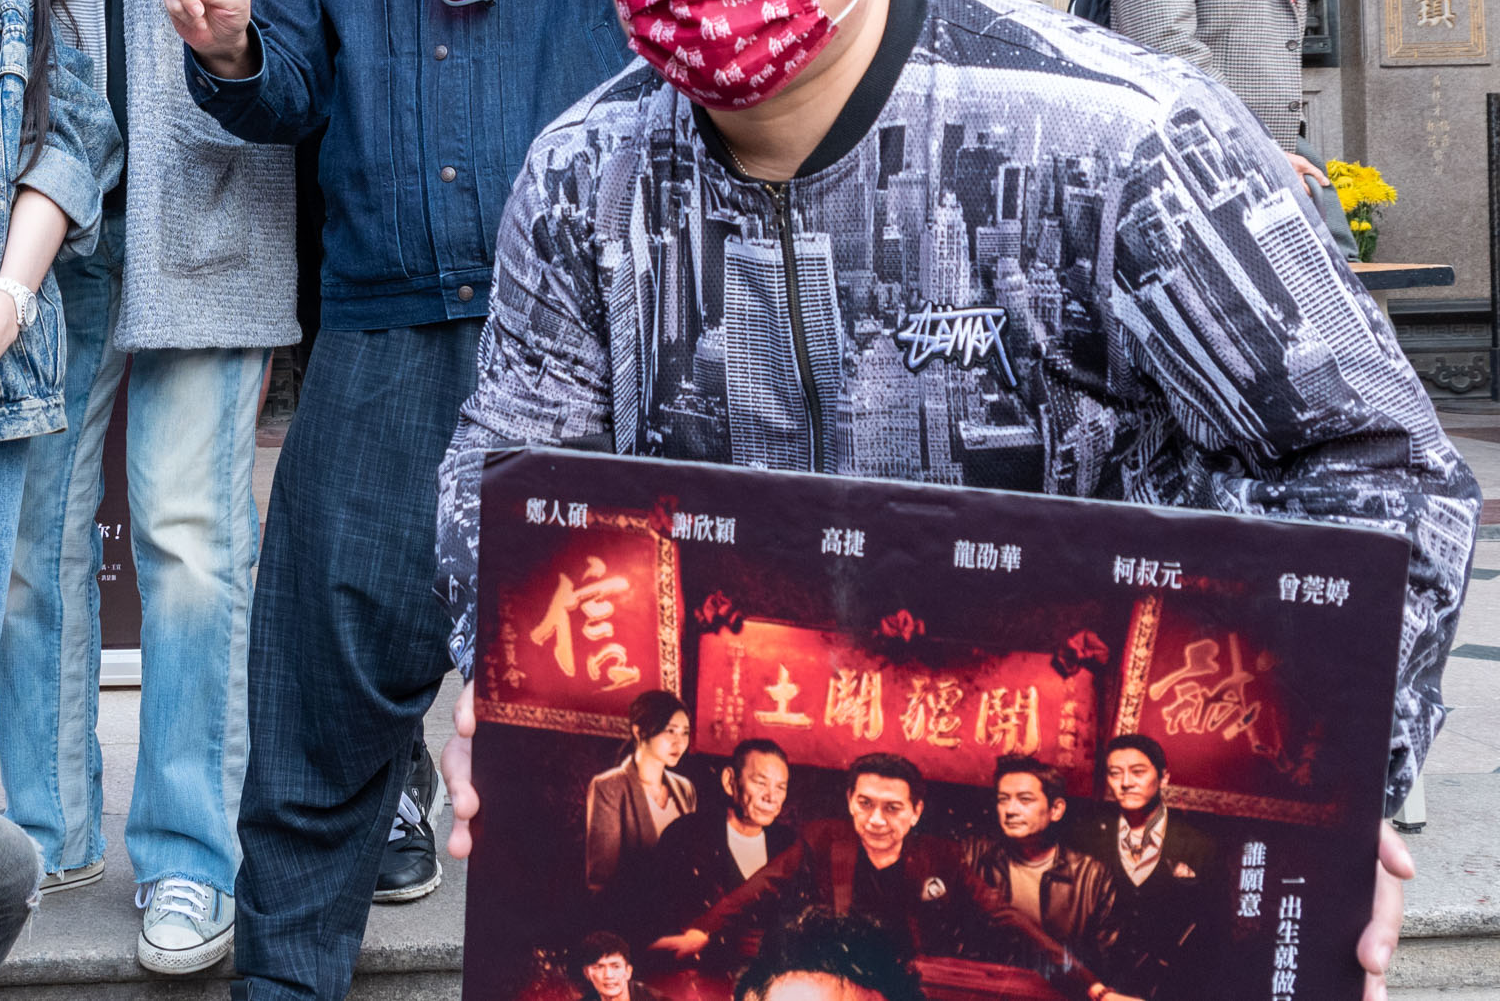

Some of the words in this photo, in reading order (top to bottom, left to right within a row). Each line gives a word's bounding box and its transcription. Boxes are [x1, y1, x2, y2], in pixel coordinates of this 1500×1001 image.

[649, 19, 676, 42] 角頭
[701, 15, 732, 40] 角頭
[768, 30, 797, 57] 角頭
[714, 61, 744, 86] 角頭
[750, 64, 776, 86] 角頭
[525, 497, 588, 529] 鄭人碩
[671, 512, 736, 544] 謝欣穎
[820, 527, 865, 557] 高捷
[953, 539, 1022, 573] 龍劭華
[1112, 556, 1183, 590] 柯叔元
[1278, 572, 1350, 607] 曾莞婷
[529, 555, 641, 694] 信
[1236, 841, 1267, 917] 誰願意
